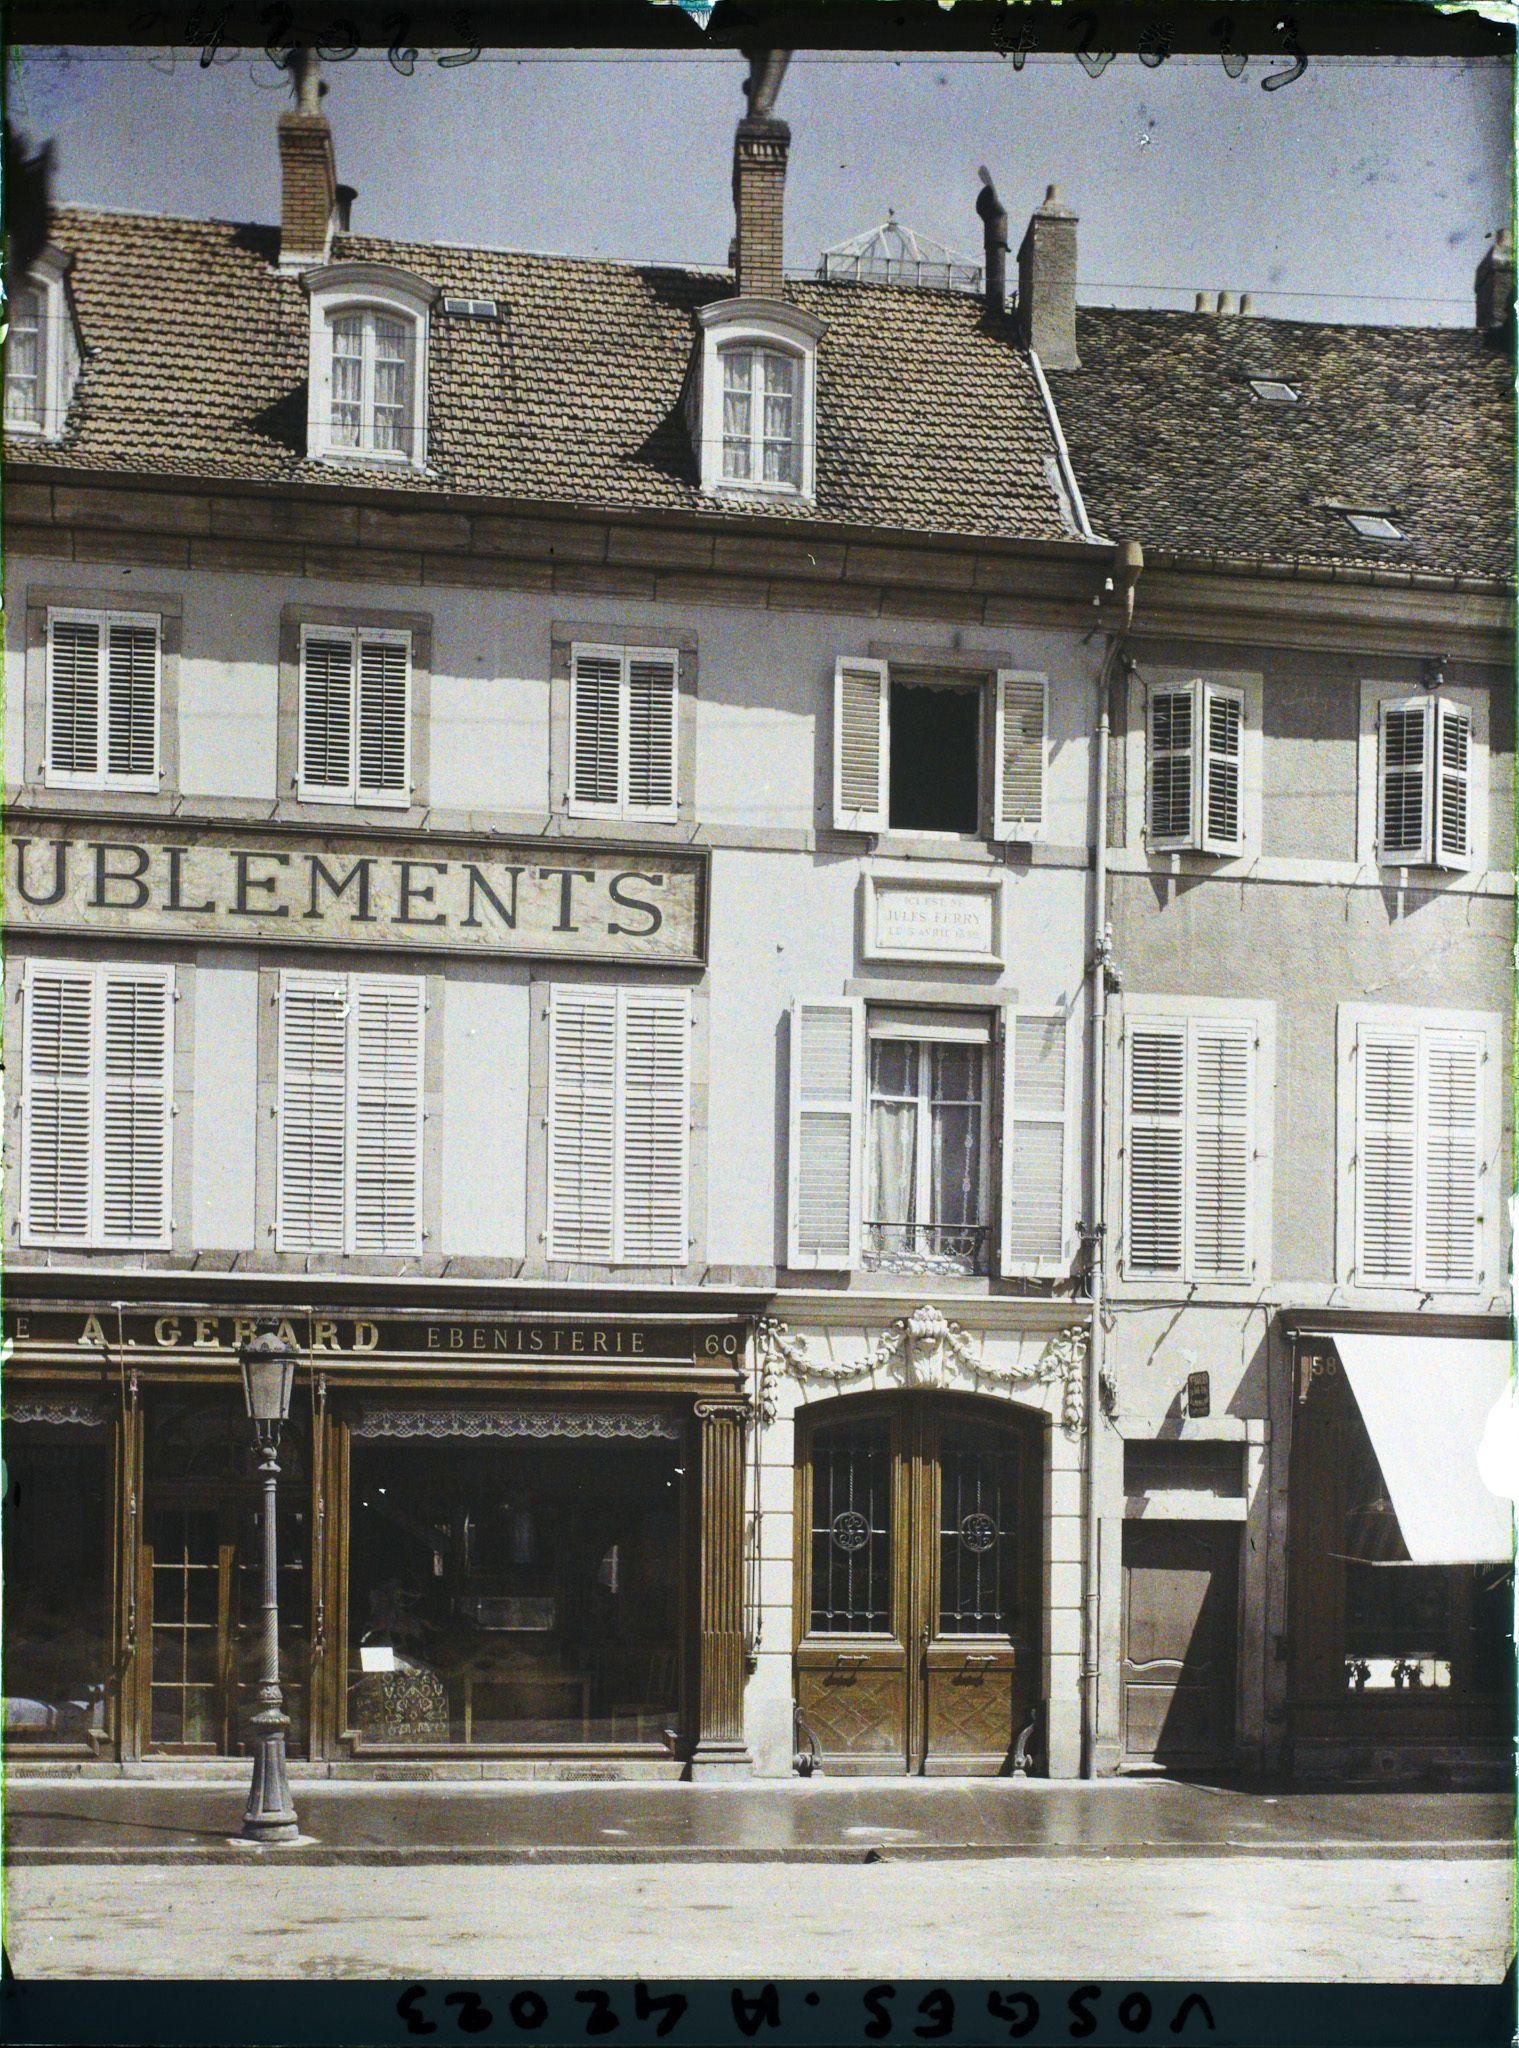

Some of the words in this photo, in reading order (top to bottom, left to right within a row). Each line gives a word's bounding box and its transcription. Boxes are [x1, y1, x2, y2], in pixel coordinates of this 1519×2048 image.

[11, 838, 664, 937] UBLEMENTS
[888, 910, 927, 922] JULES
[934, 912, 981, 925] FERRY
[153, 1317, 380, 1351] GERARD
[427, 1327, 646, 1353] EBENISTERIE
[704, 1334, 738, 1355] 60
[1312, 1356, 1336, 1376] 58
[397, 1982, 688, 2036] 42023
